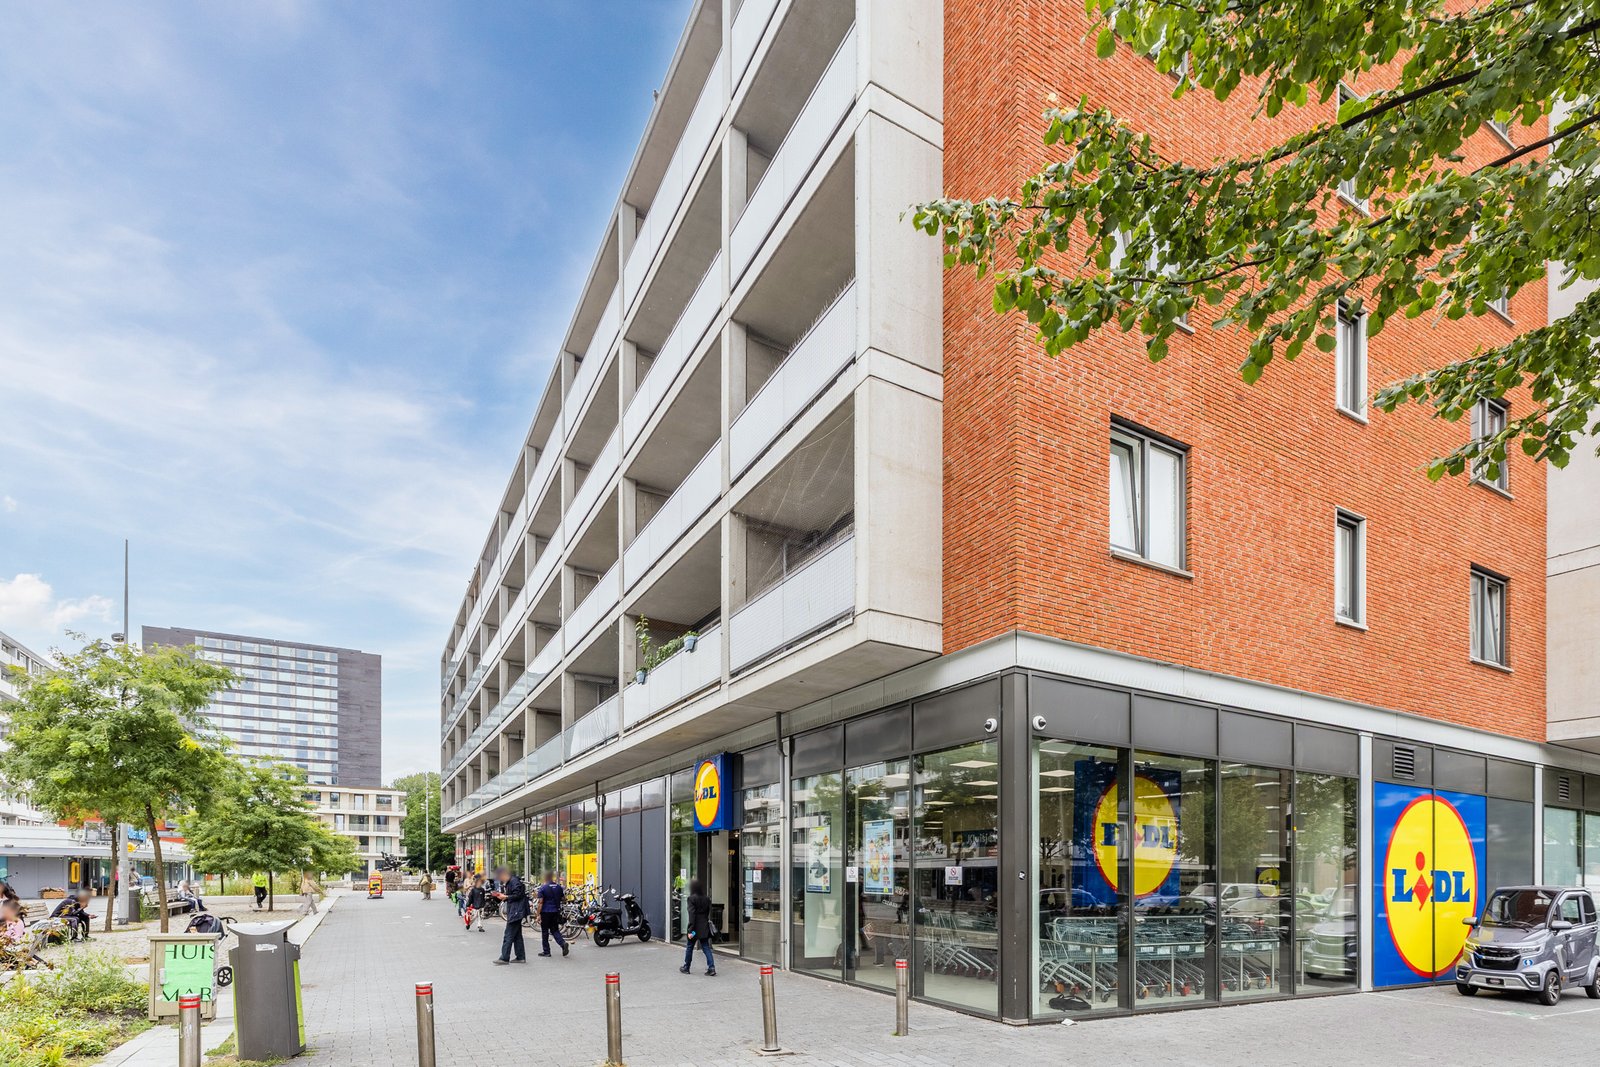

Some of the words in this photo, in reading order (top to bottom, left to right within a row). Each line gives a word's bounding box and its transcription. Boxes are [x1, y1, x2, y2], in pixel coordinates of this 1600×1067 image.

[695, 784, 717, 803] LIDL
[1391, 856, 1471, 908] LIDL
[164, 944, 215, 960] HUIS
